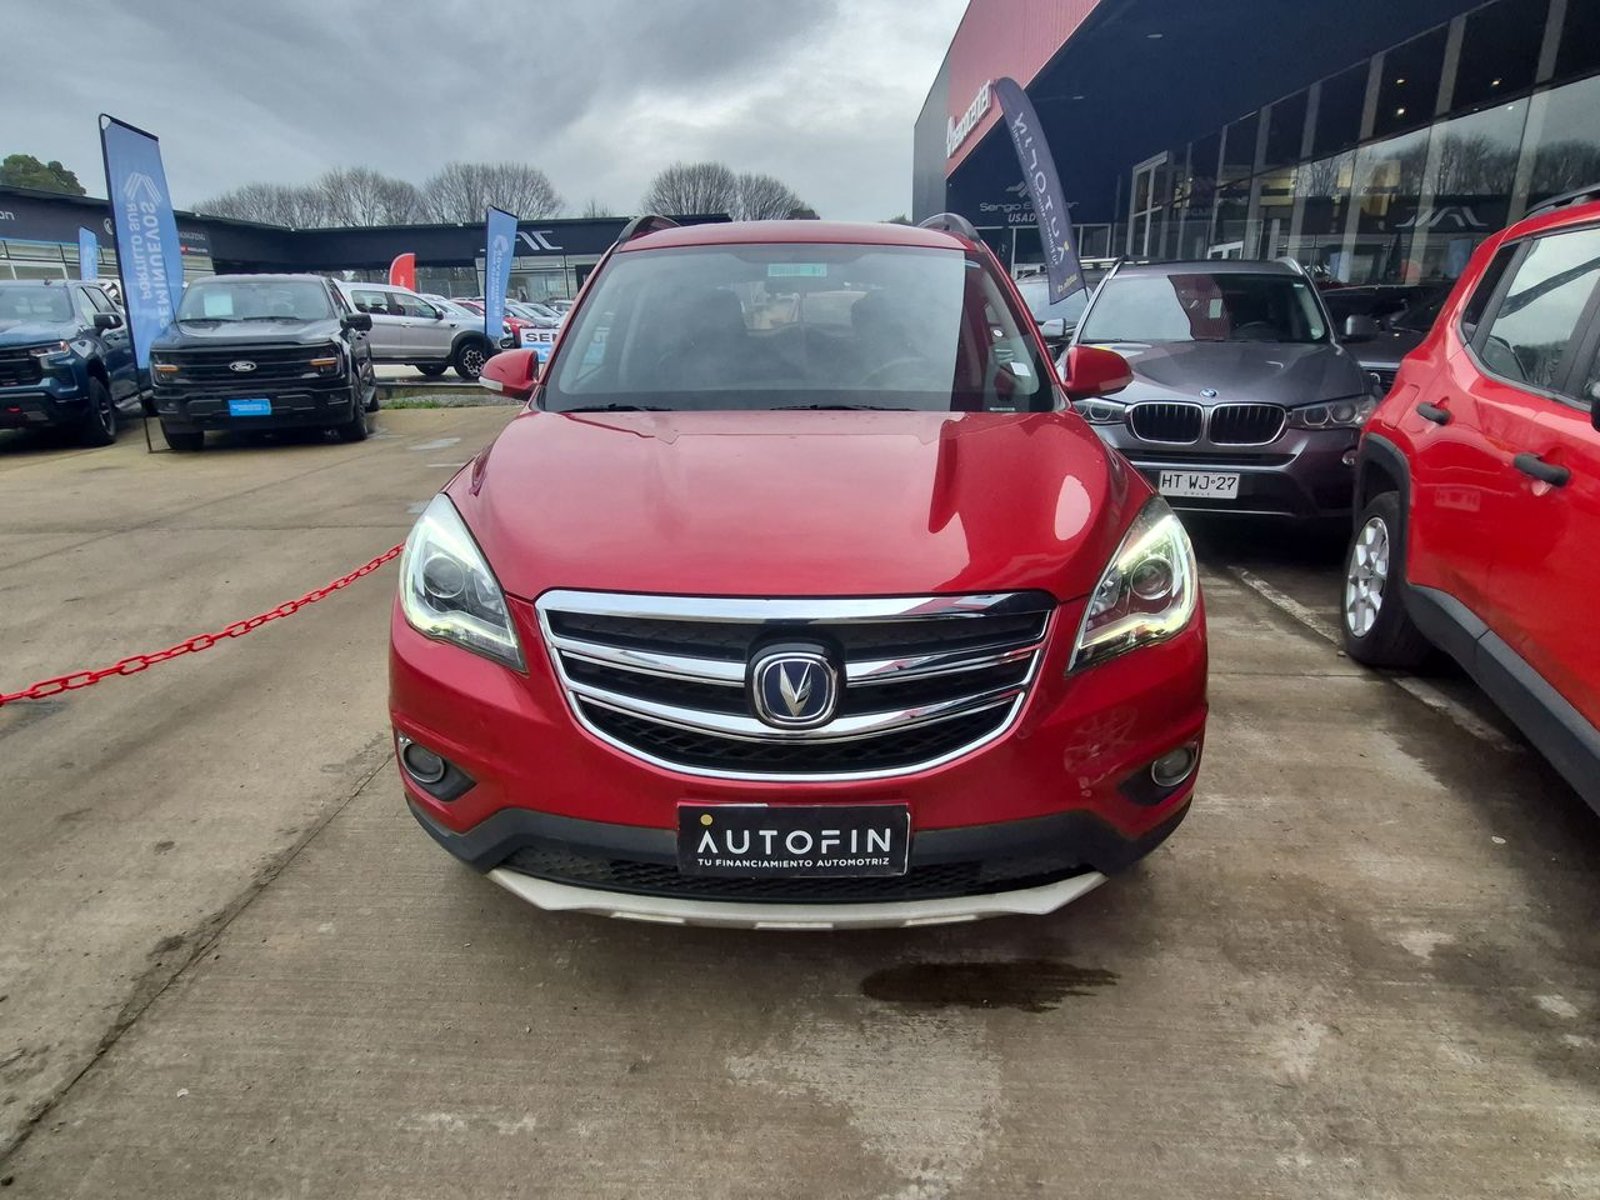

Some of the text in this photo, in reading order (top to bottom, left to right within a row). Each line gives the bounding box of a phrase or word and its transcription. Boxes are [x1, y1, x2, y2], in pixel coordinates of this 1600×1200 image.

[697, 828, 891, 855] AUTOFIN
[697, 857, 889, 869] TU FINANCIAMIENTO AUTOMOTRIZ
